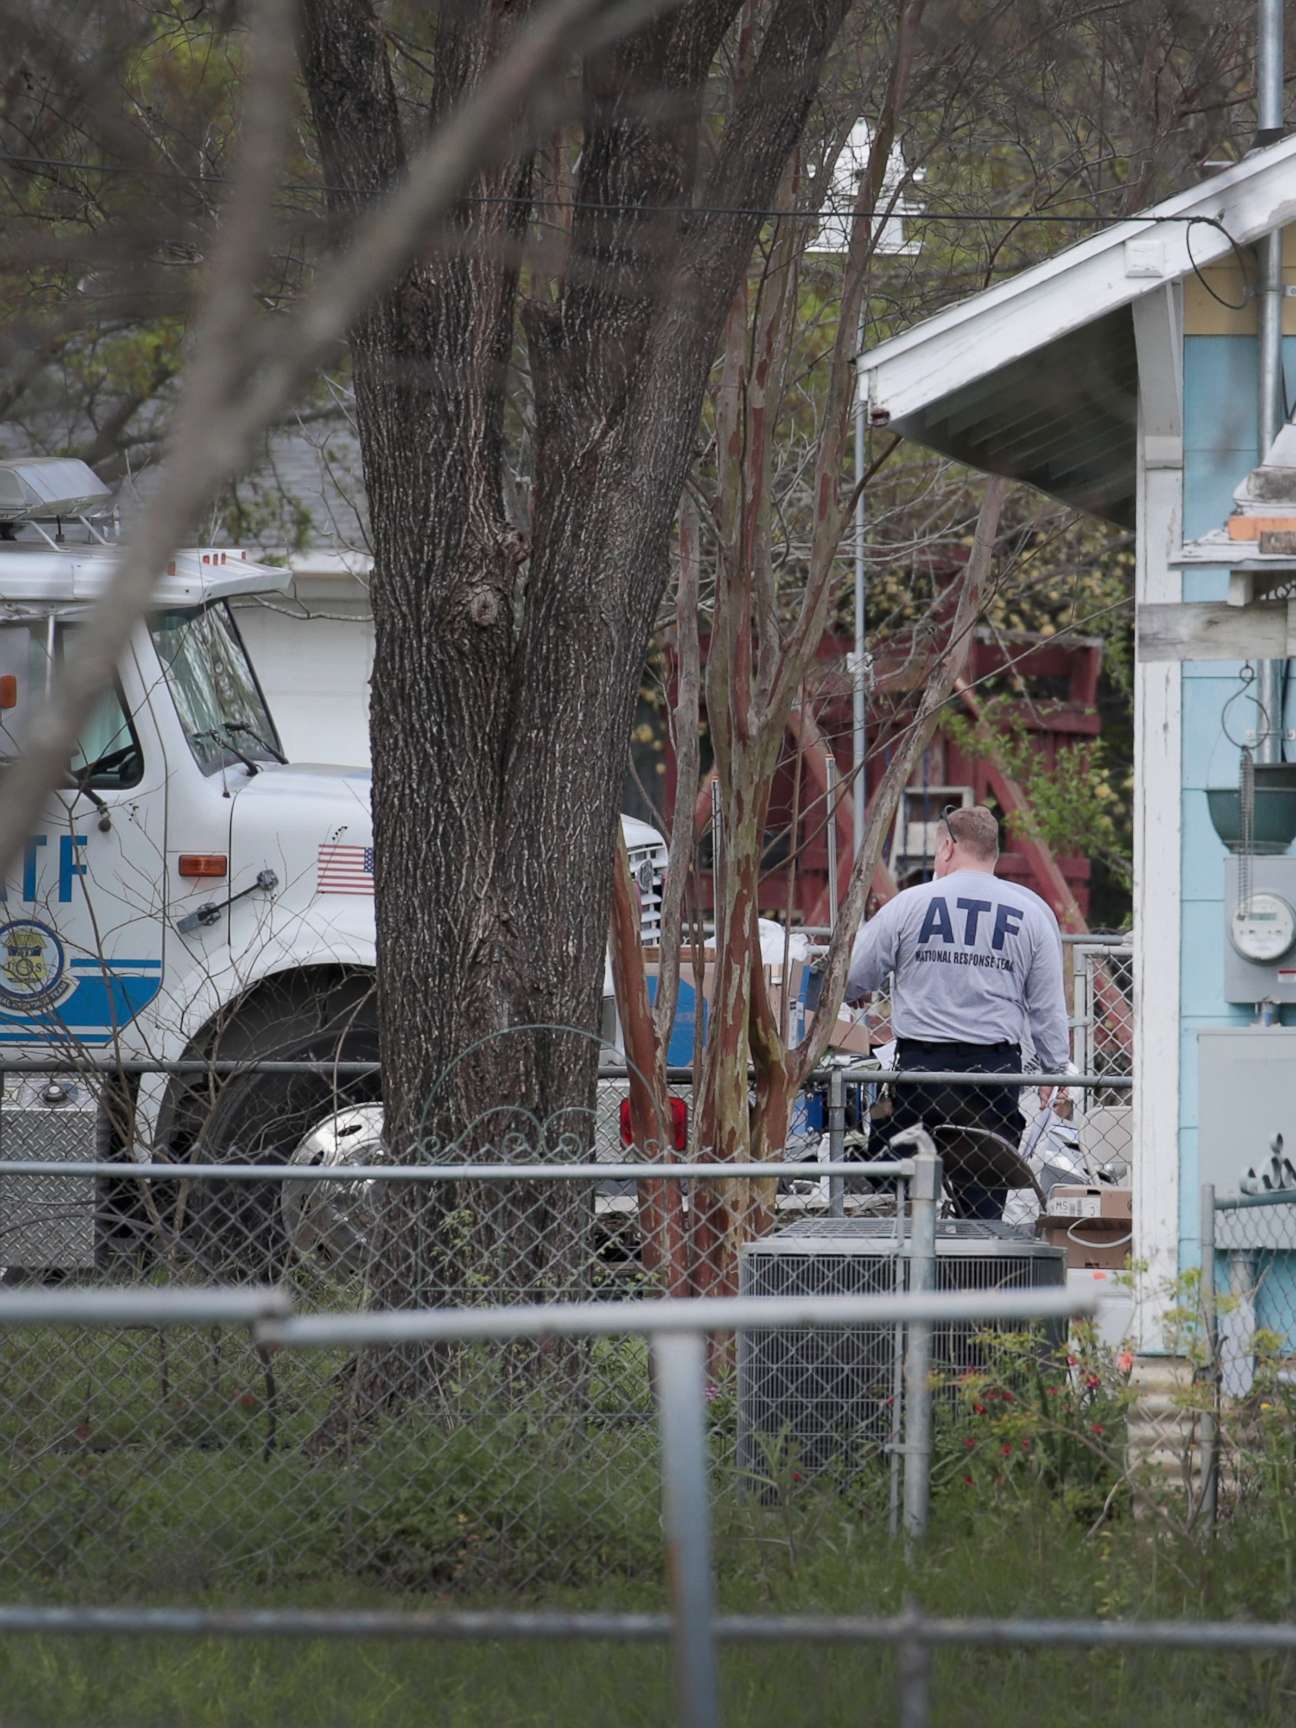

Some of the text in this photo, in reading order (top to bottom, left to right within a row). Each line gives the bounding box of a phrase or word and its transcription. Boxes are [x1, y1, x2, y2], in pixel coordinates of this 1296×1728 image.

[0, 835, 87, 903] TF
[917, 896, 1024, 951] ATF
[915, 949, 952, 964] NATIONAL
[953, 952, 996, 969] RESPONSE
